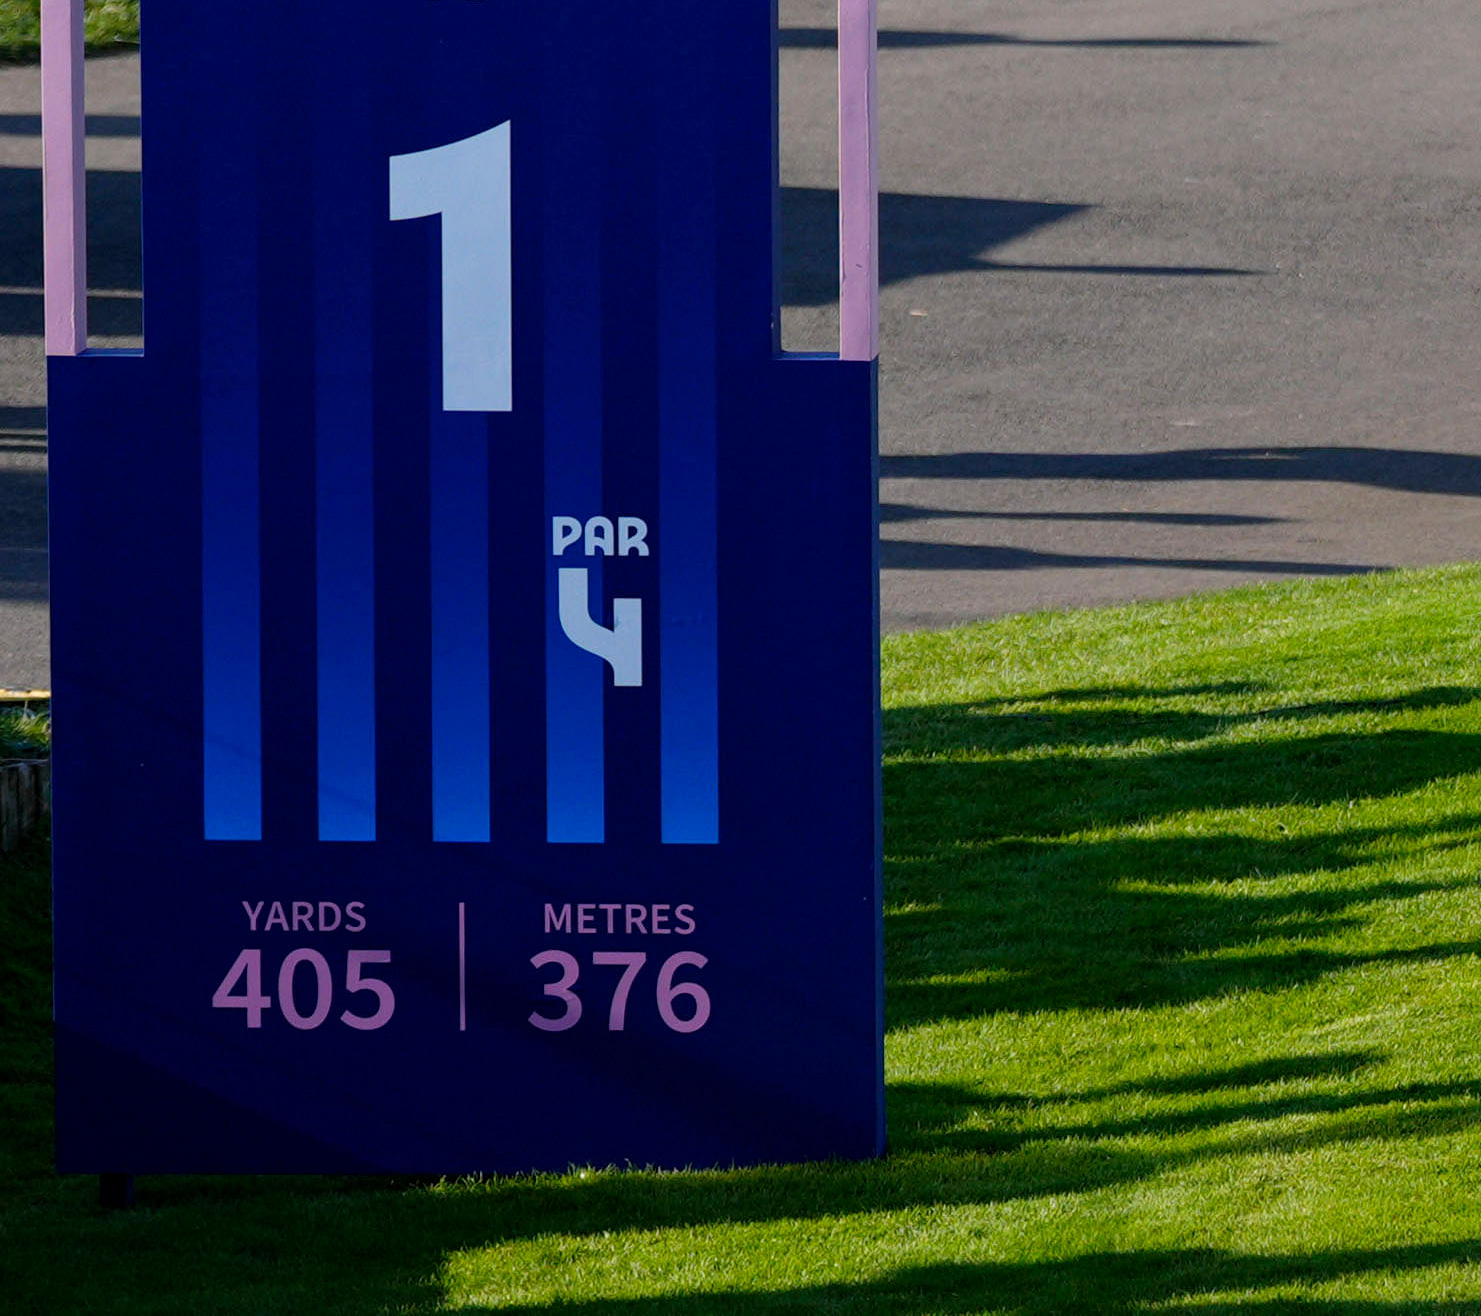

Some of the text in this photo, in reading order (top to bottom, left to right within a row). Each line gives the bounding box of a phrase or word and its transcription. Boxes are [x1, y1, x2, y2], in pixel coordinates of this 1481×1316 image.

[388, 119, 513, 413] 1
[552, 515, 650, 557] PAR
[558, 567, 643, 687] 4
[242, 901, 367, 932] YARDS
[543, 903, 696, 935] METRES
[211, 947, 396, 1031] 405
[528, 949, 711, 1033] 376
